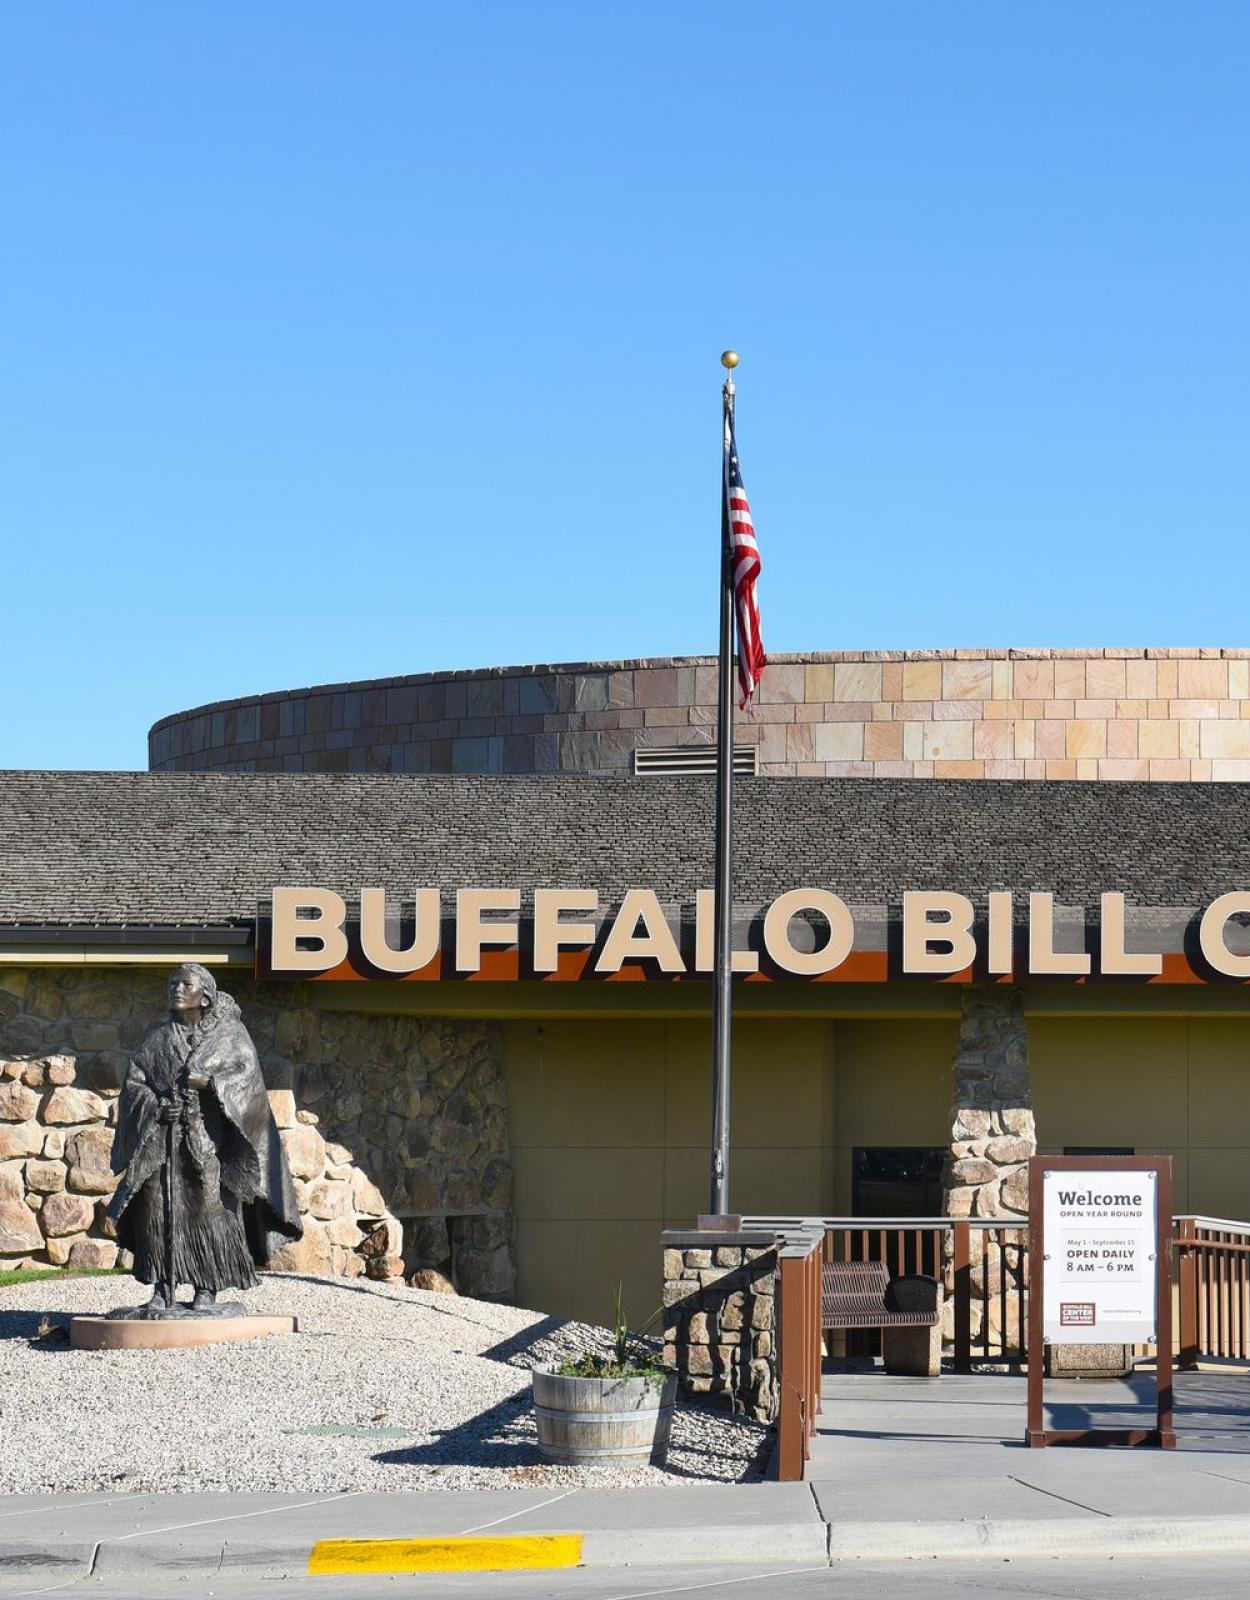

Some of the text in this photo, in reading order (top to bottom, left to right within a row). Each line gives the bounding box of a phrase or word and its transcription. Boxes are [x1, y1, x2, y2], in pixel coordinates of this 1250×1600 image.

[271, 887, 855, 975] BUFFALO
[903, 890, 1163, 975] BILL
[1057, 1190, 1143, 1206] Welcome
[1059, 1210, 1143, 1218] OPEN YEAR ROUND
[1067, 1239, 1081, 1247] May
[1092, 1239, 1126, 1247] September
[1066, 1249, 1135, 1259] OPEN DAILY
[1066, 1261, 1074, 1272] 8
[1076, 1263, 1095, 1272] AM
[1106, 1261, 1114, 1272] 6
[1116, 1263, 1135, 1272] PM
